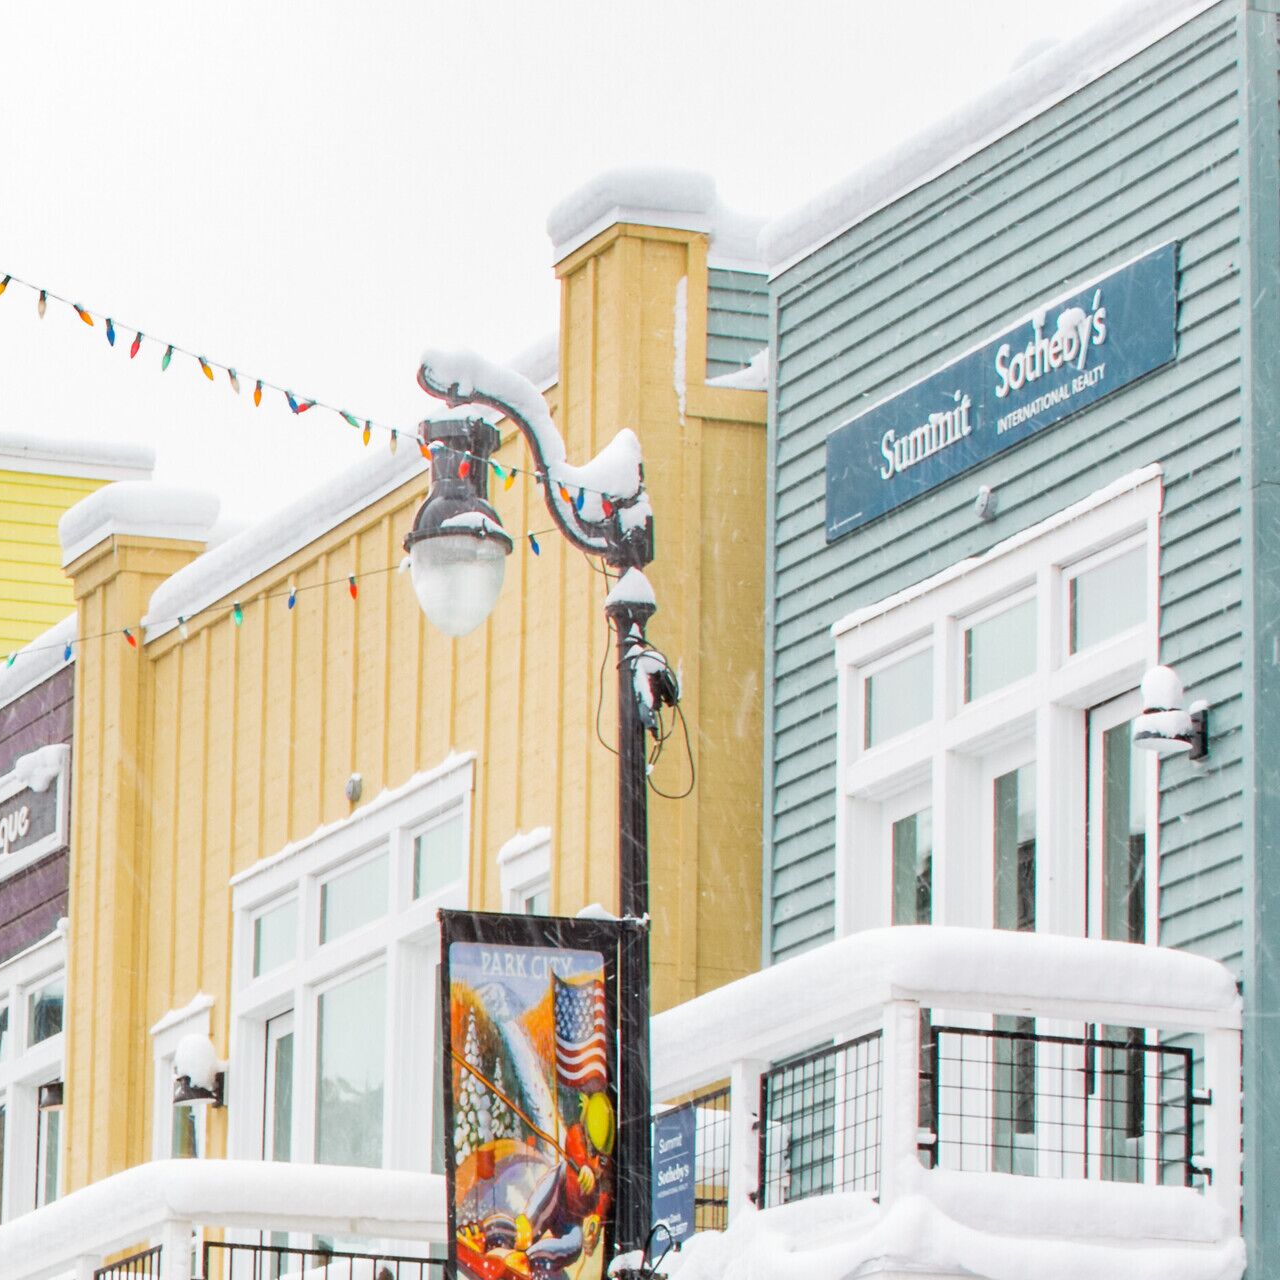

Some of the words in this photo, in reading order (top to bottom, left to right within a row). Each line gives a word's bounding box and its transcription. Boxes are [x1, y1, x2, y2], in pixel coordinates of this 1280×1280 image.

[880, 389, 972, 480] Summit
[994, 288, 1107, 399] Sotheby's
[996, 382, 1071, 436] INTERNATIONAL
[1071, 363, 1107, 395] REALTY
[480, 951, 528, 977] PARK
[530, 954, 573, 979] CITY
